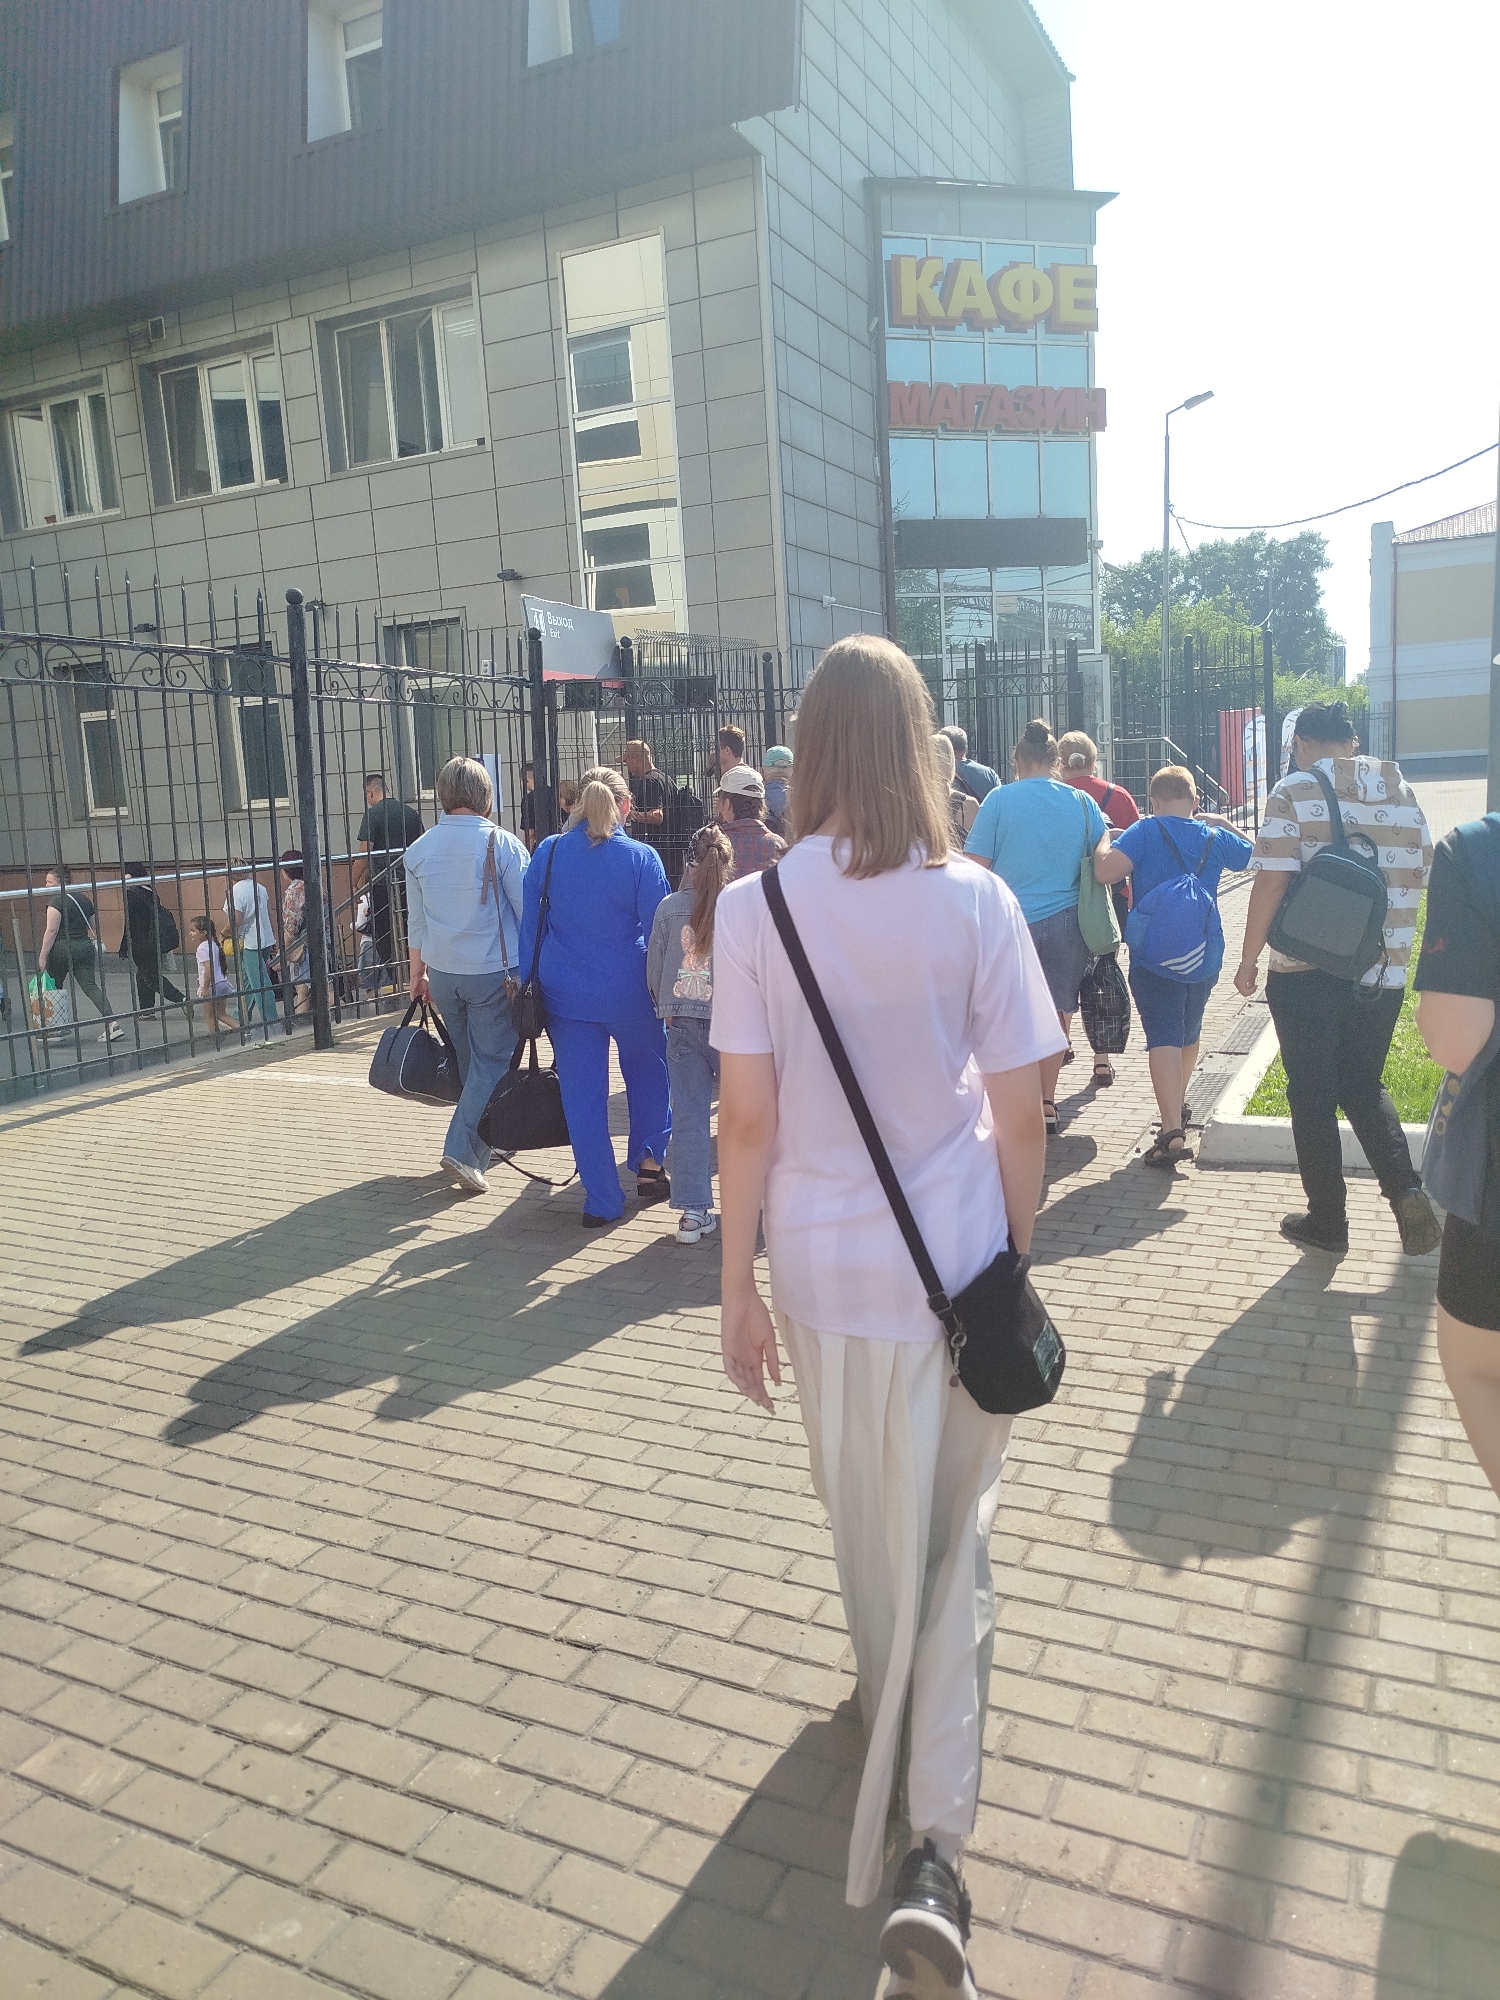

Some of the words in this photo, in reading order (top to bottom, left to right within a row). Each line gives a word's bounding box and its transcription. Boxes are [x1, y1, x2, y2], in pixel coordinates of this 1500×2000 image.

[891, 254, 1098, 331] КАФЕ
[888, 381, 1106, 432] МАГАЗИН
[546, 611, 575, 631] Выход
[550, 628, 561, 639] Exit
